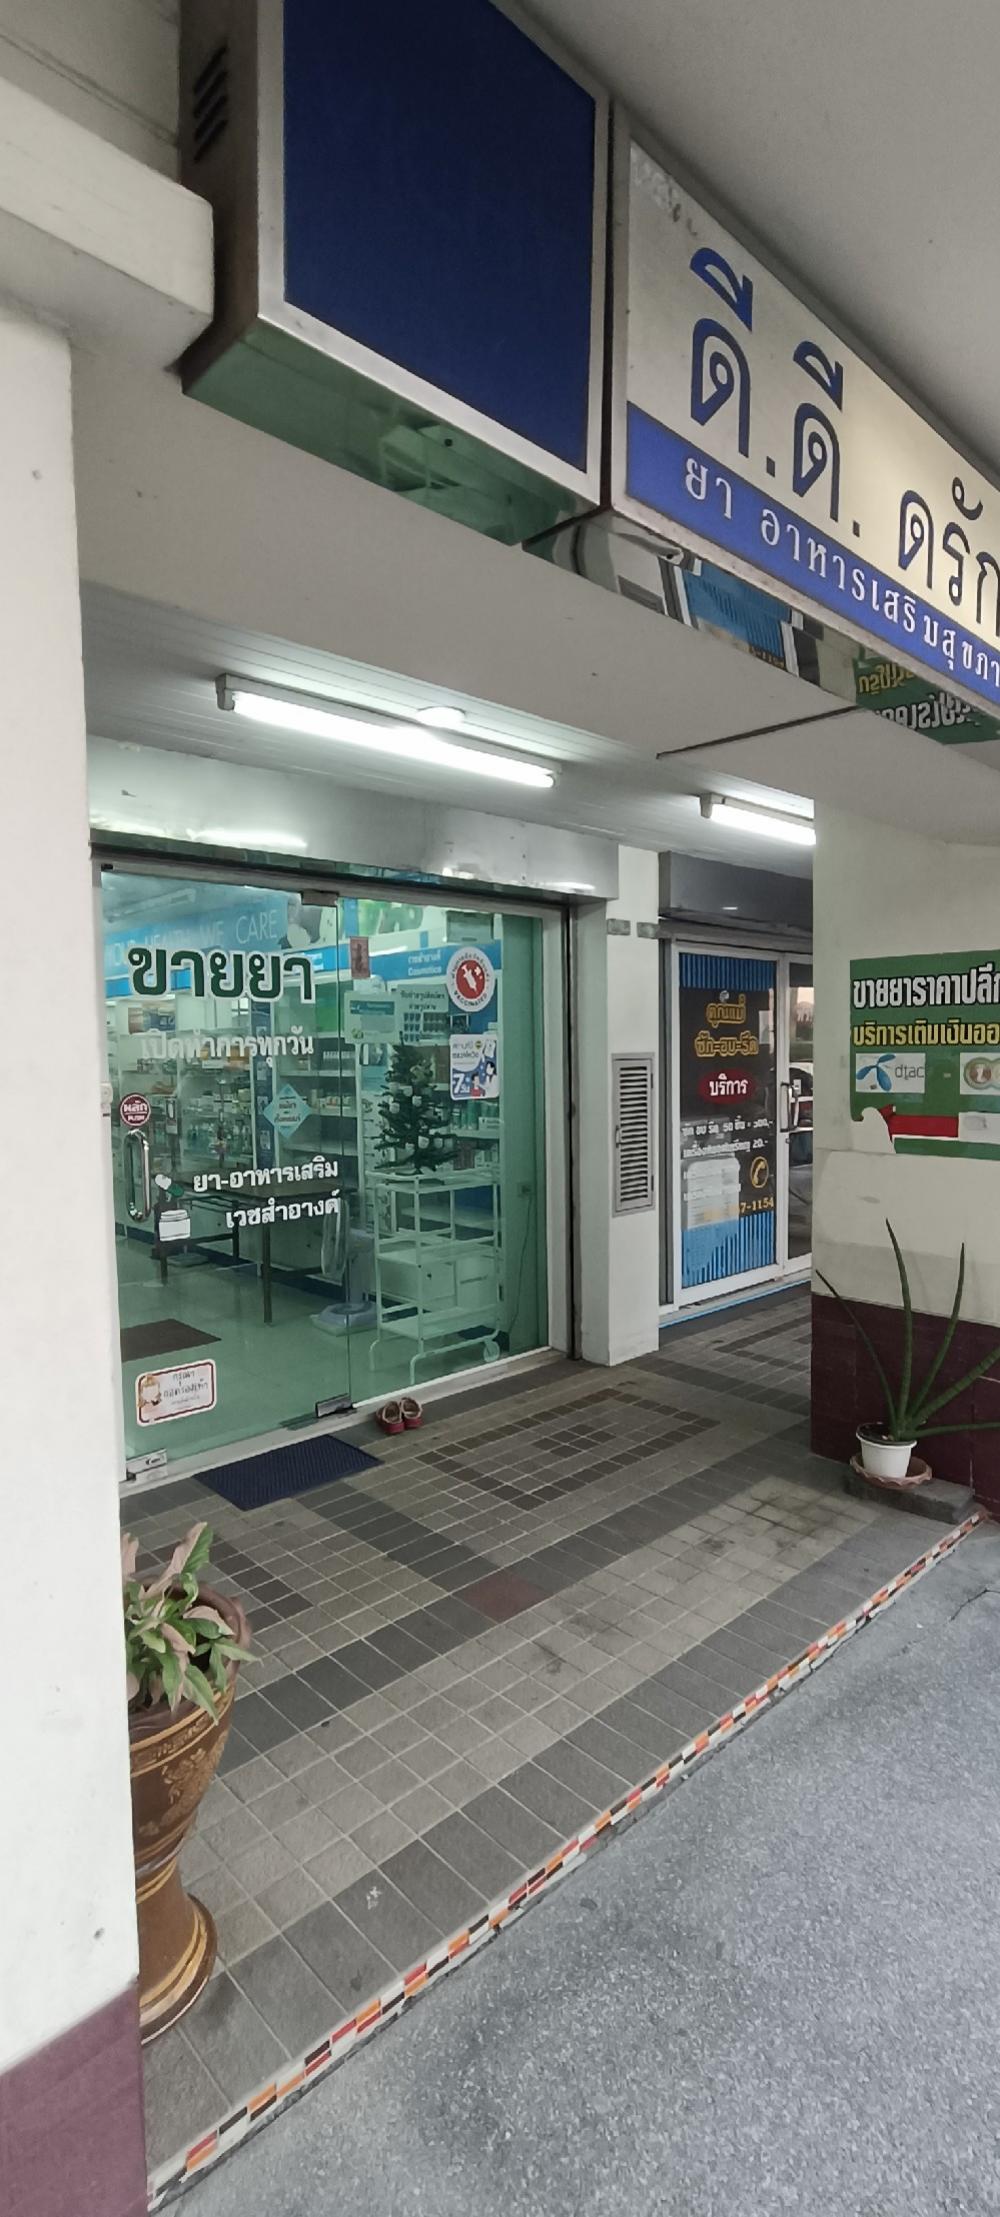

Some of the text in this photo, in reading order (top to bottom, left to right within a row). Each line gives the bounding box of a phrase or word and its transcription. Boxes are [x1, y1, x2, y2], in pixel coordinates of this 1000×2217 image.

[685, 457, 732, 520] ยา
[236, 909, 279, 945] CARE
[126, 945, 315, 1003] ขายยา
[141, 1026, 314, 1067] เปิดทำการทุกวัน
[709, 1072, 749, 1097] บริการ
[894, 1064, 925, 1080] dtac
[123, 1099, 148, 1113] ผลัก
[193, 1155, 339, 1193] ยา-อาหารเสริม
[226, 1188, 341, 1229] เวชสำอางค์
